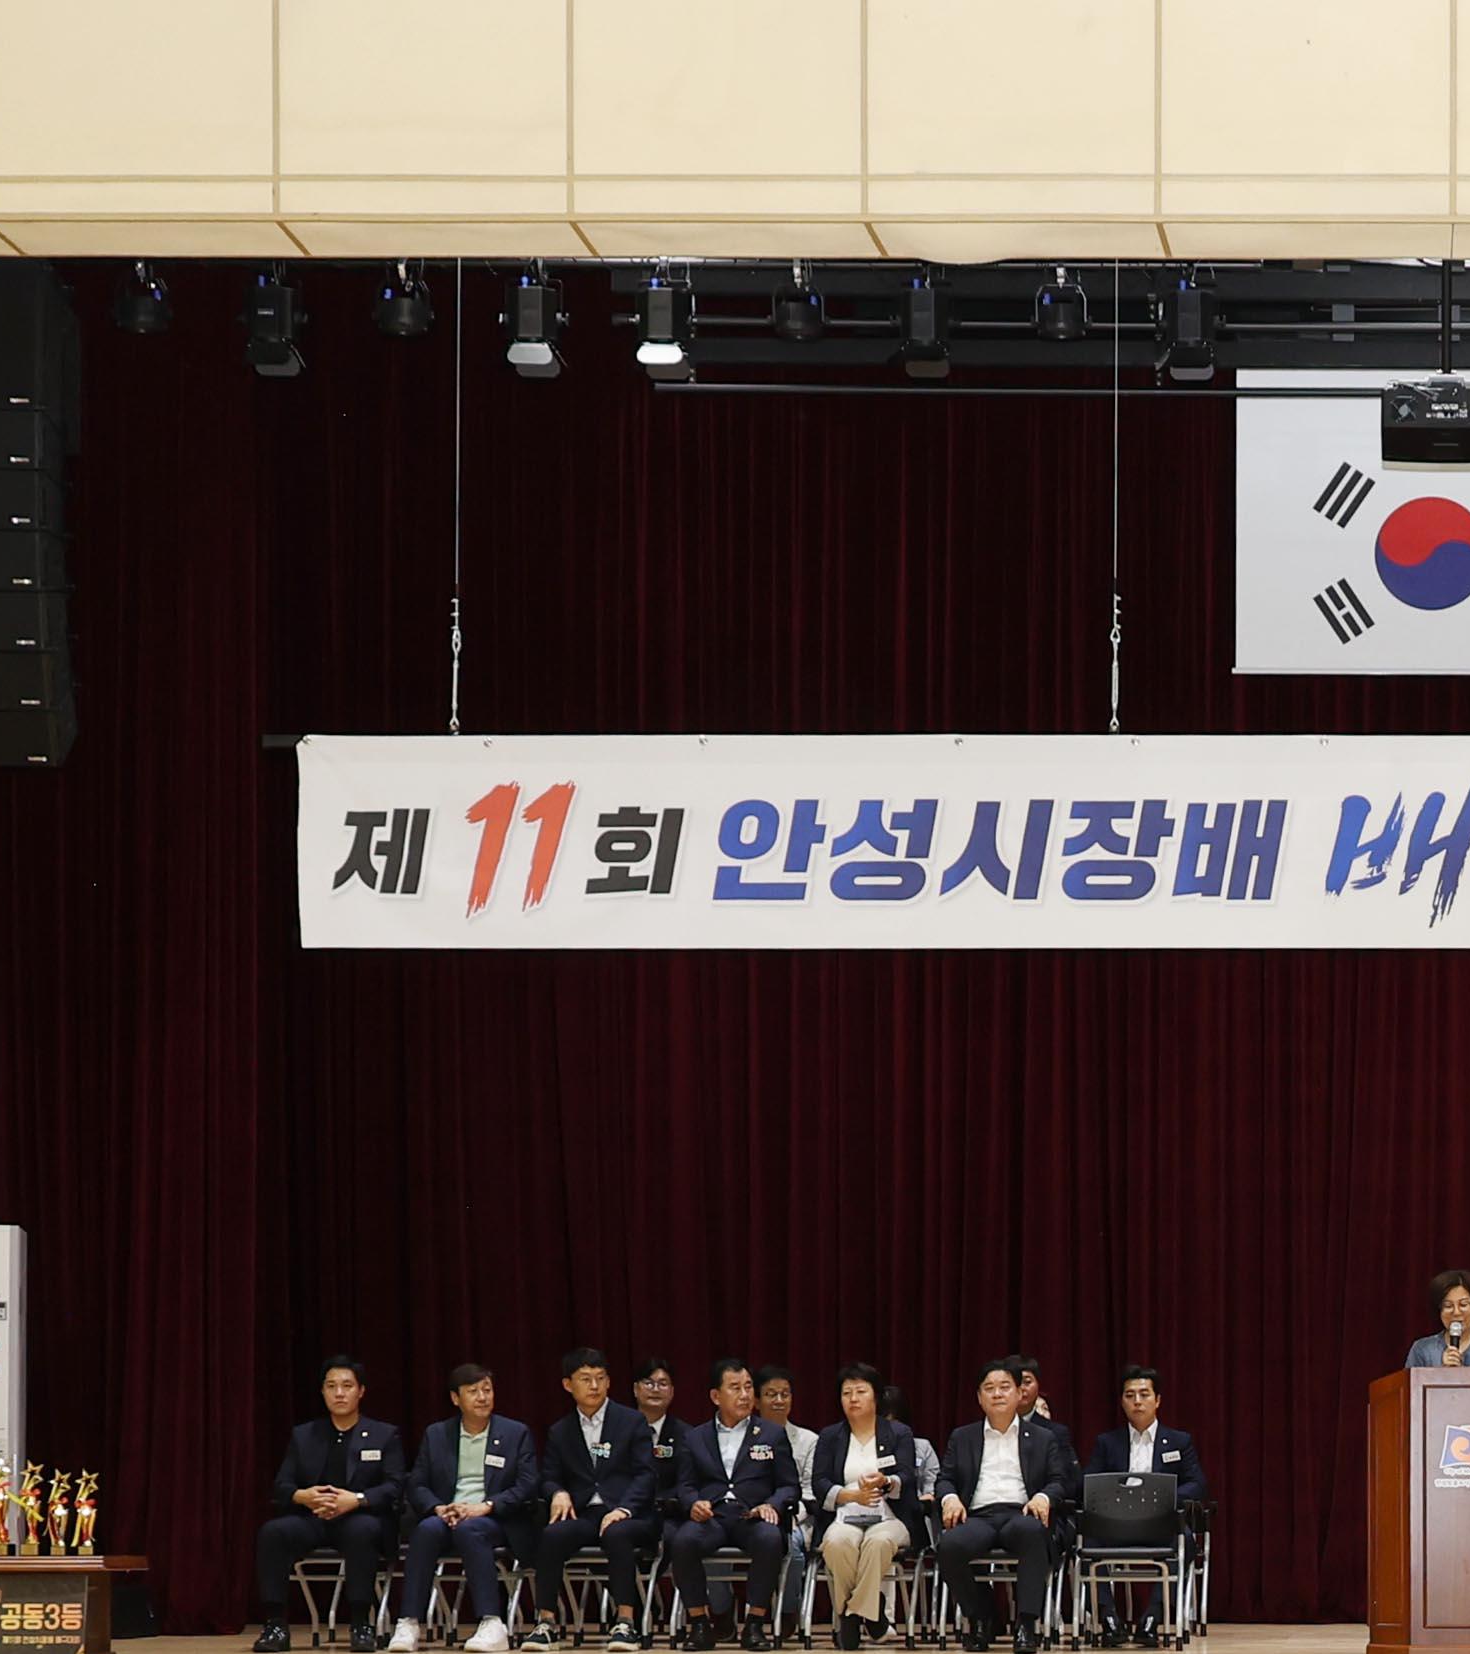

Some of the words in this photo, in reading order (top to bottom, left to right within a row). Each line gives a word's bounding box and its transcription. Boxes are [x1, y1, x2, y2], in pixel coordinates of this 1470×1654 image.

[332, 807, 430, 896] 제
[463, 780, 575, 920] 11
[586, 806, 684, 895] 회
[711, 799, 1288, 902] 안성시장배
[0, 1603, 83, 1630] 공동3등
